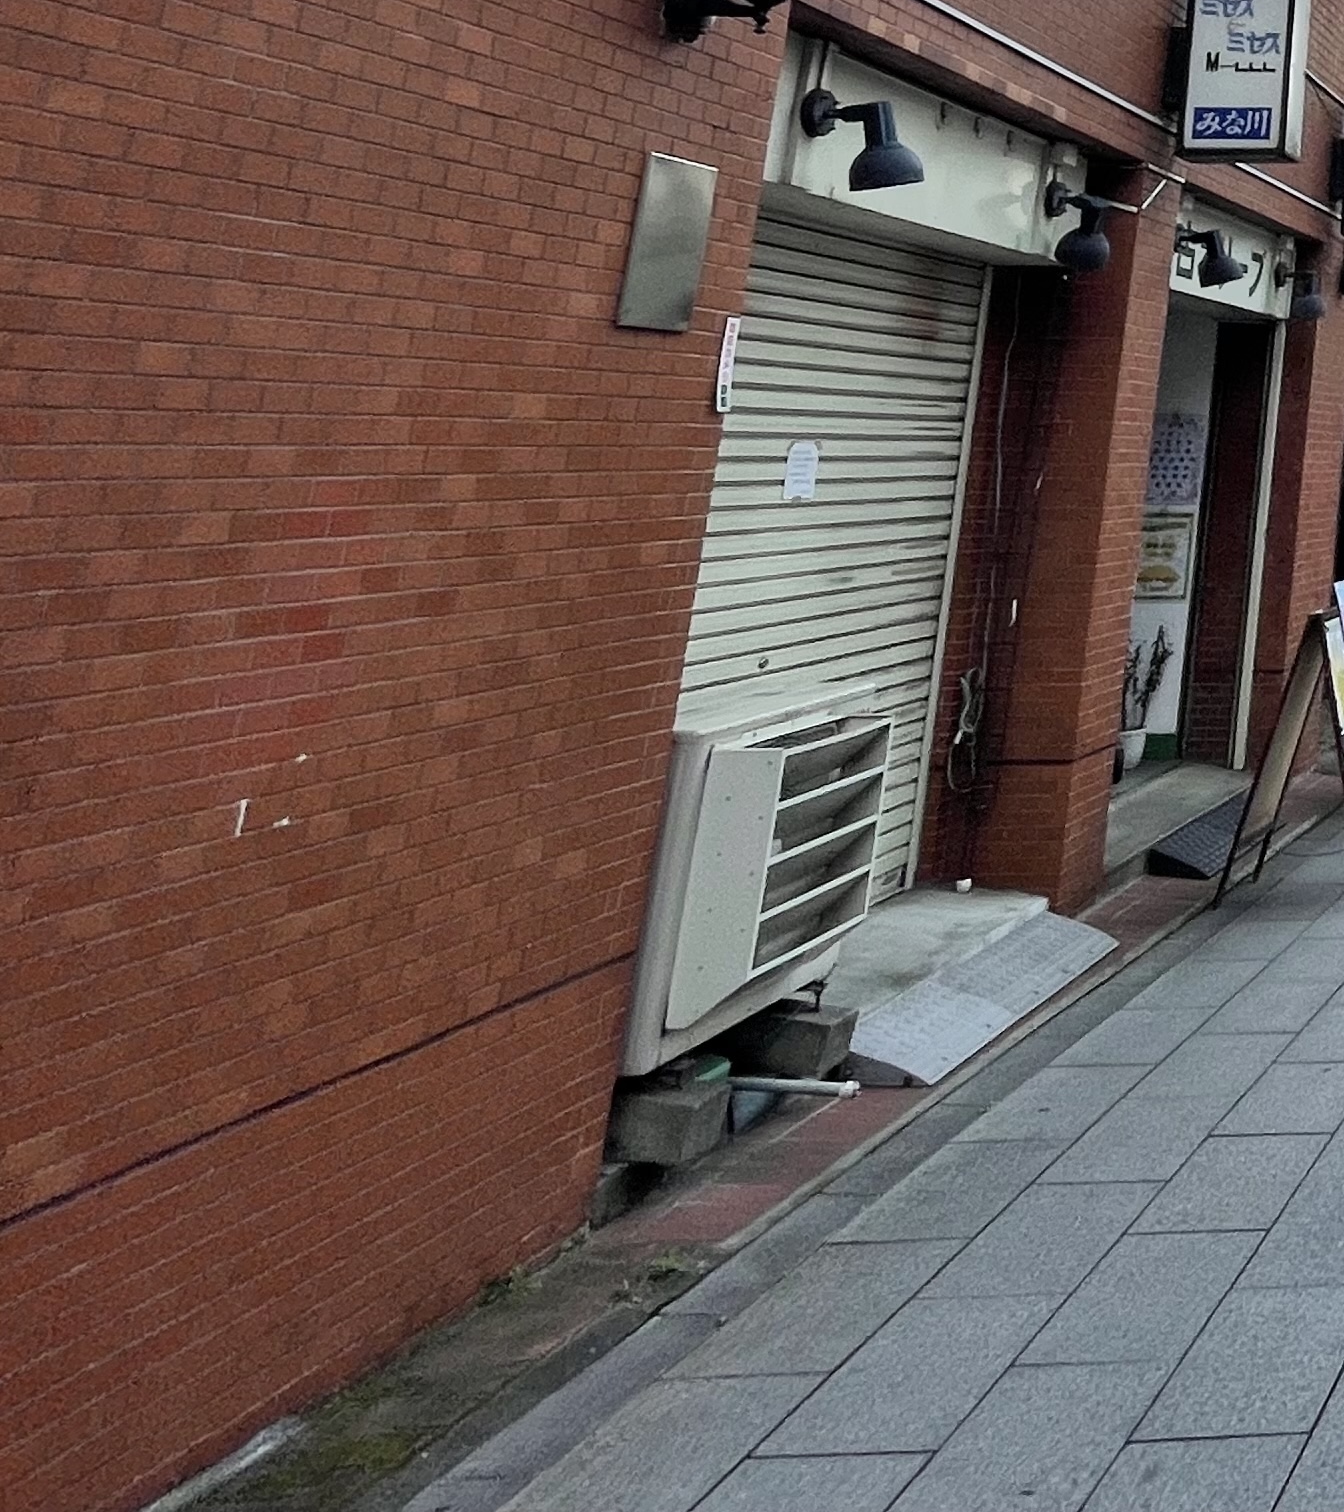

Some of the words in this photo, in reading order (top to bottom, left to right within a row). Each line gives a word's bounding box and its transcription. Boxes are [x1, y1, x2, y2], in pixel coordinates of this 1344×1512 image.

[1226, 31, 1281, 55] ミセス
[1195, 109, 1269, 138] みな川
